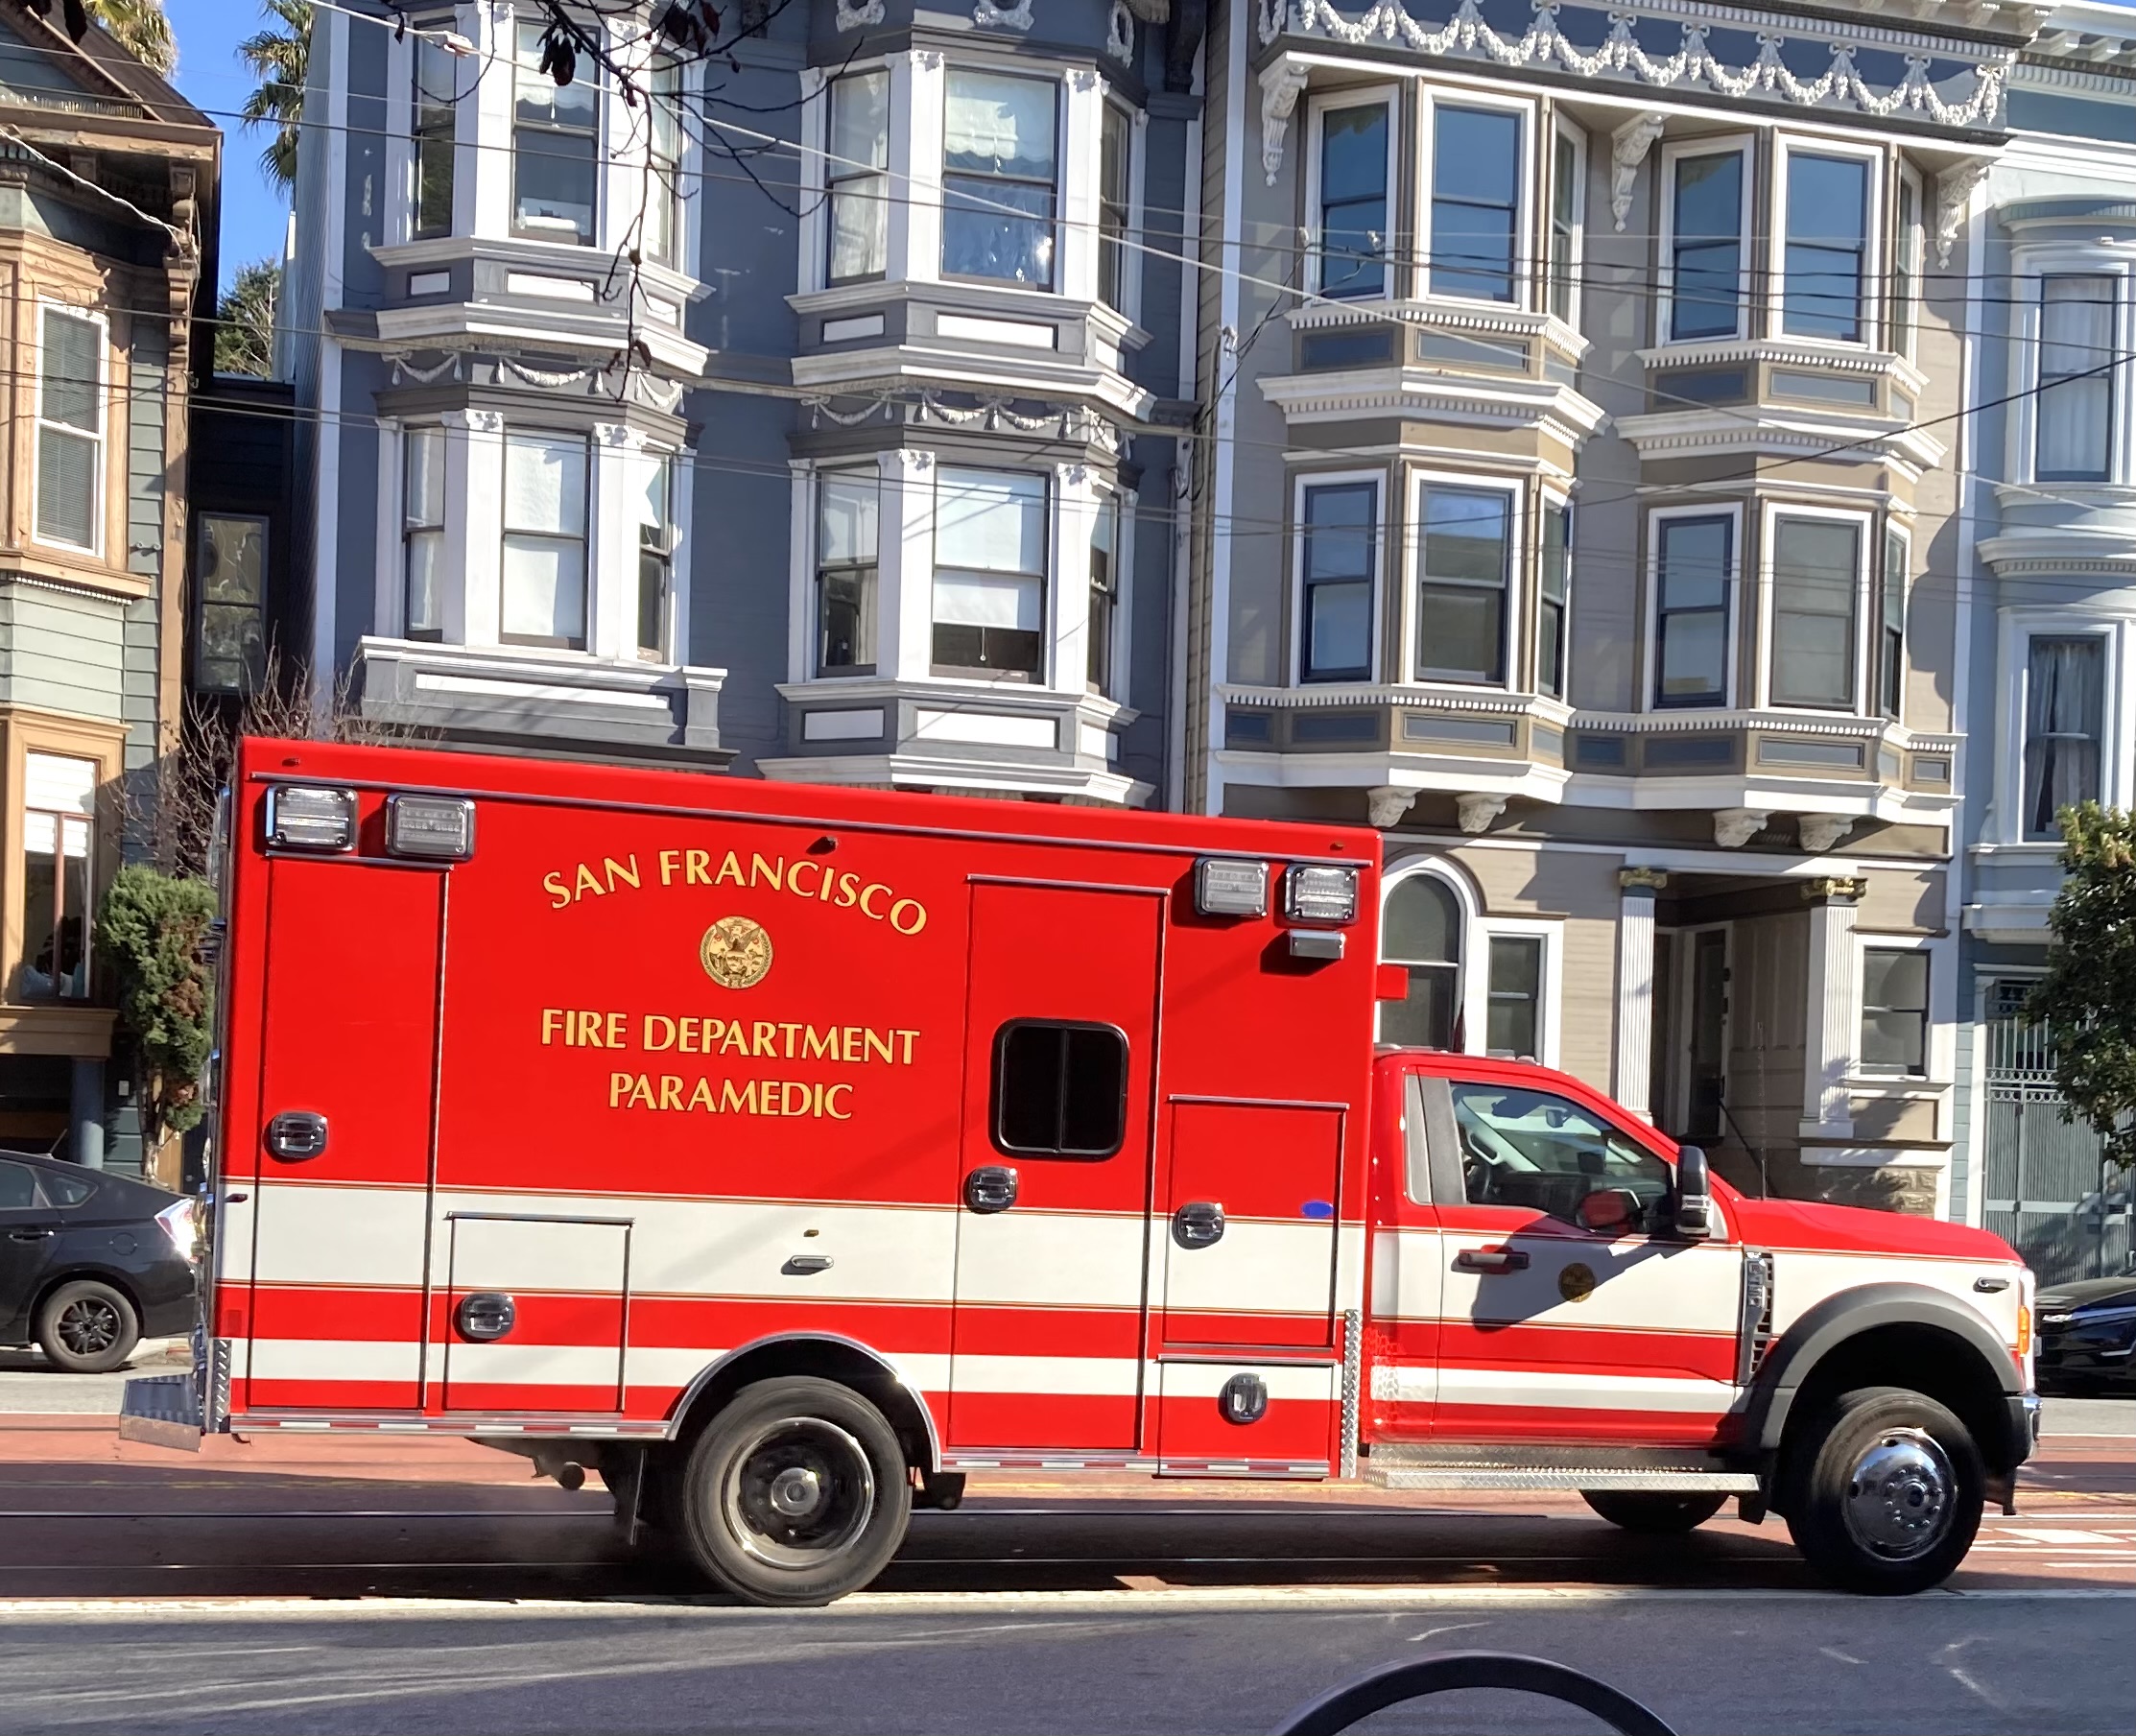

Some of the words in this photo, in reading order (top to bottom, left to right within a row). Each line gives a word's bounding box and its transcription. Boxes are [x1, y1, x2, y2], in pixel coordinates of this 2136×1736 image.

[542, 852, 642, 910] SAN
[658, 848, 928, 937] FRANCISCO
[541, 1009, 629, 1050] FIRE
[642, 1013, 921, 1066] DEPARTMENT
[609, 1072, 854, 1121] PARAMEDIC
